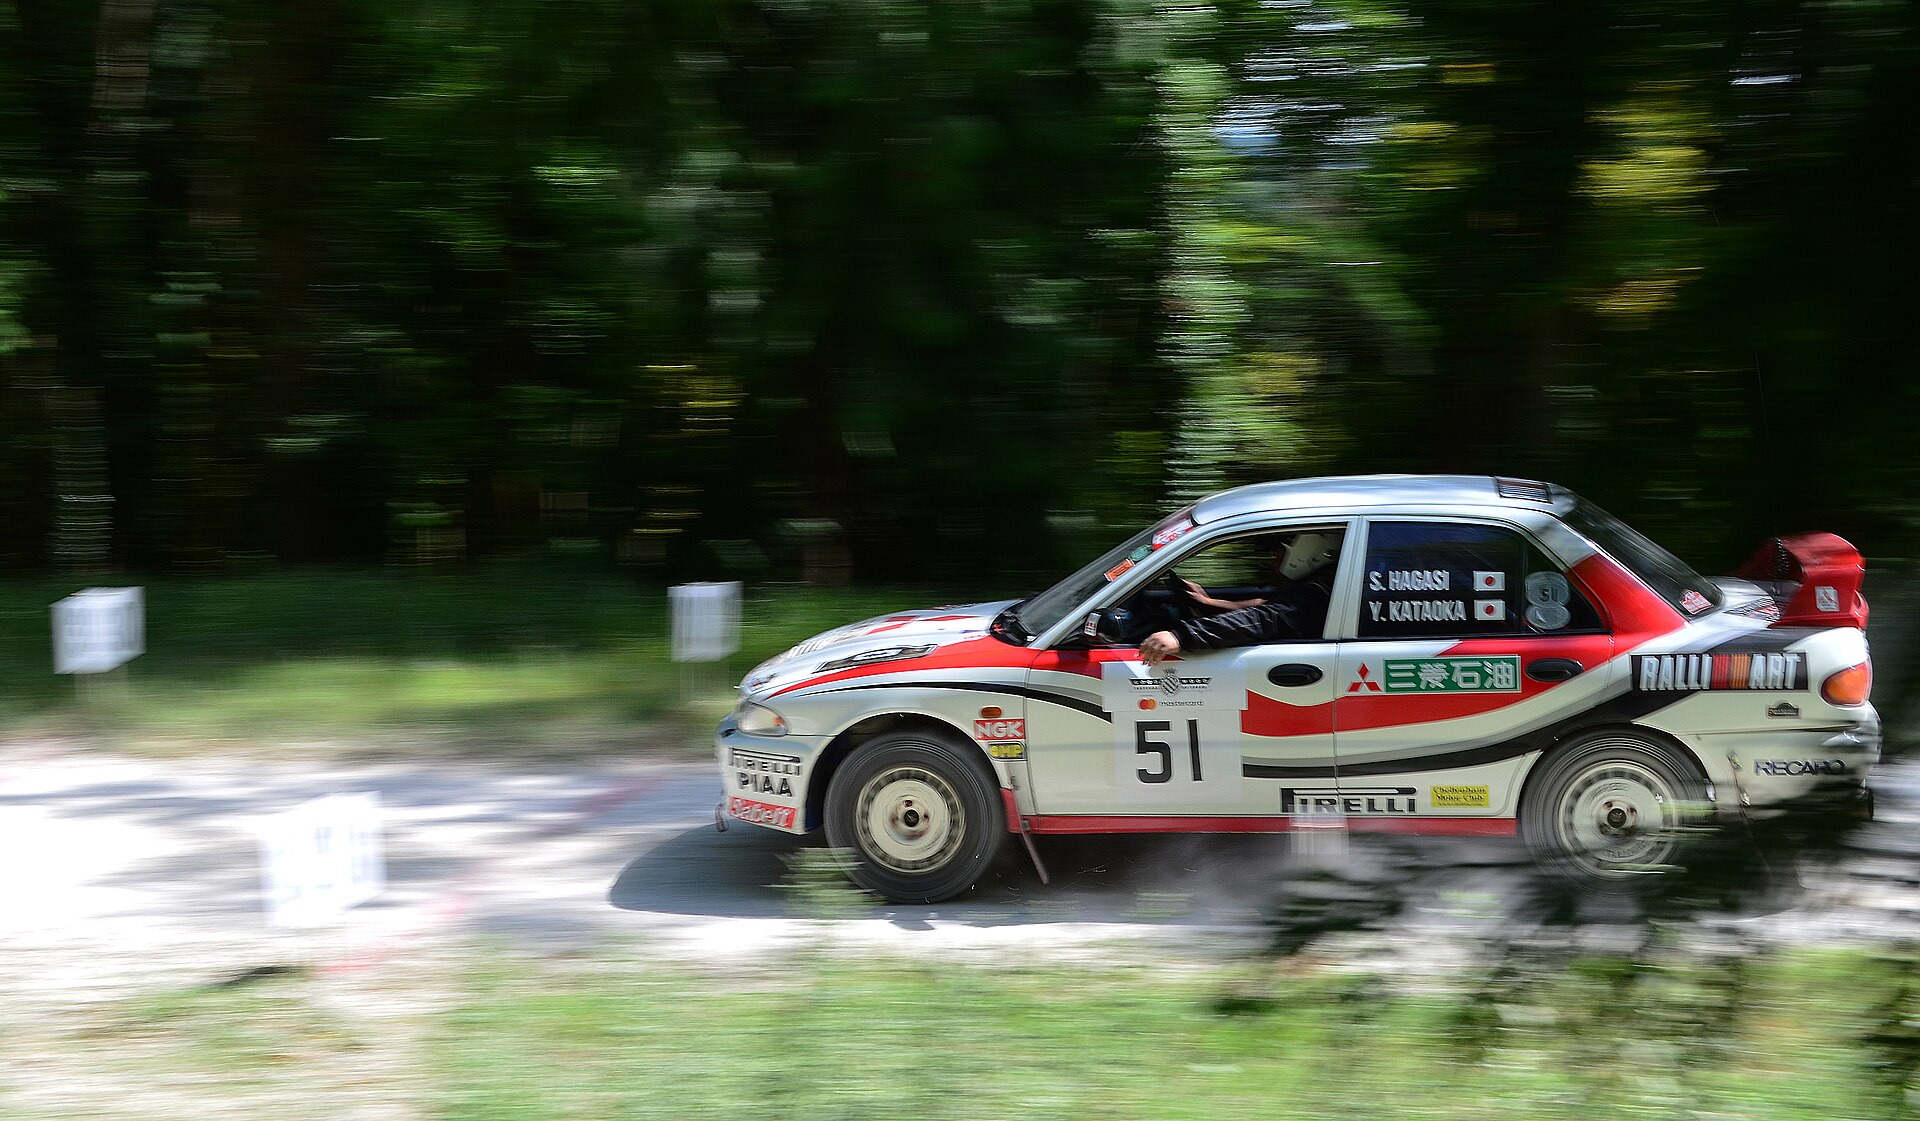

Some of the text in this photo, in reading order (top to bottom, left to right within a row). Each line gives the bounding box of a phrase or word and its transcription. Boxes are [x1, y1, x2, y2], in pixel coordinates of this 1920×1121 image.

[1369, 570, 1450, 591] S. HAGASI
[1368, 600, 1467, 621] Y. KATAOKA
[1387, 660, 1516, 690] 三菱石油
[1639, 652, 1801, 691] RALLI ART
[976, 721, 1023, 738] NGK
[1136, 719, 1203, 784] 51
[1755, 760, 1846, 776] RECARO
[736, 772, 793, 797] PIAA
[1281, 788, 1417, 813] PIRELLI
